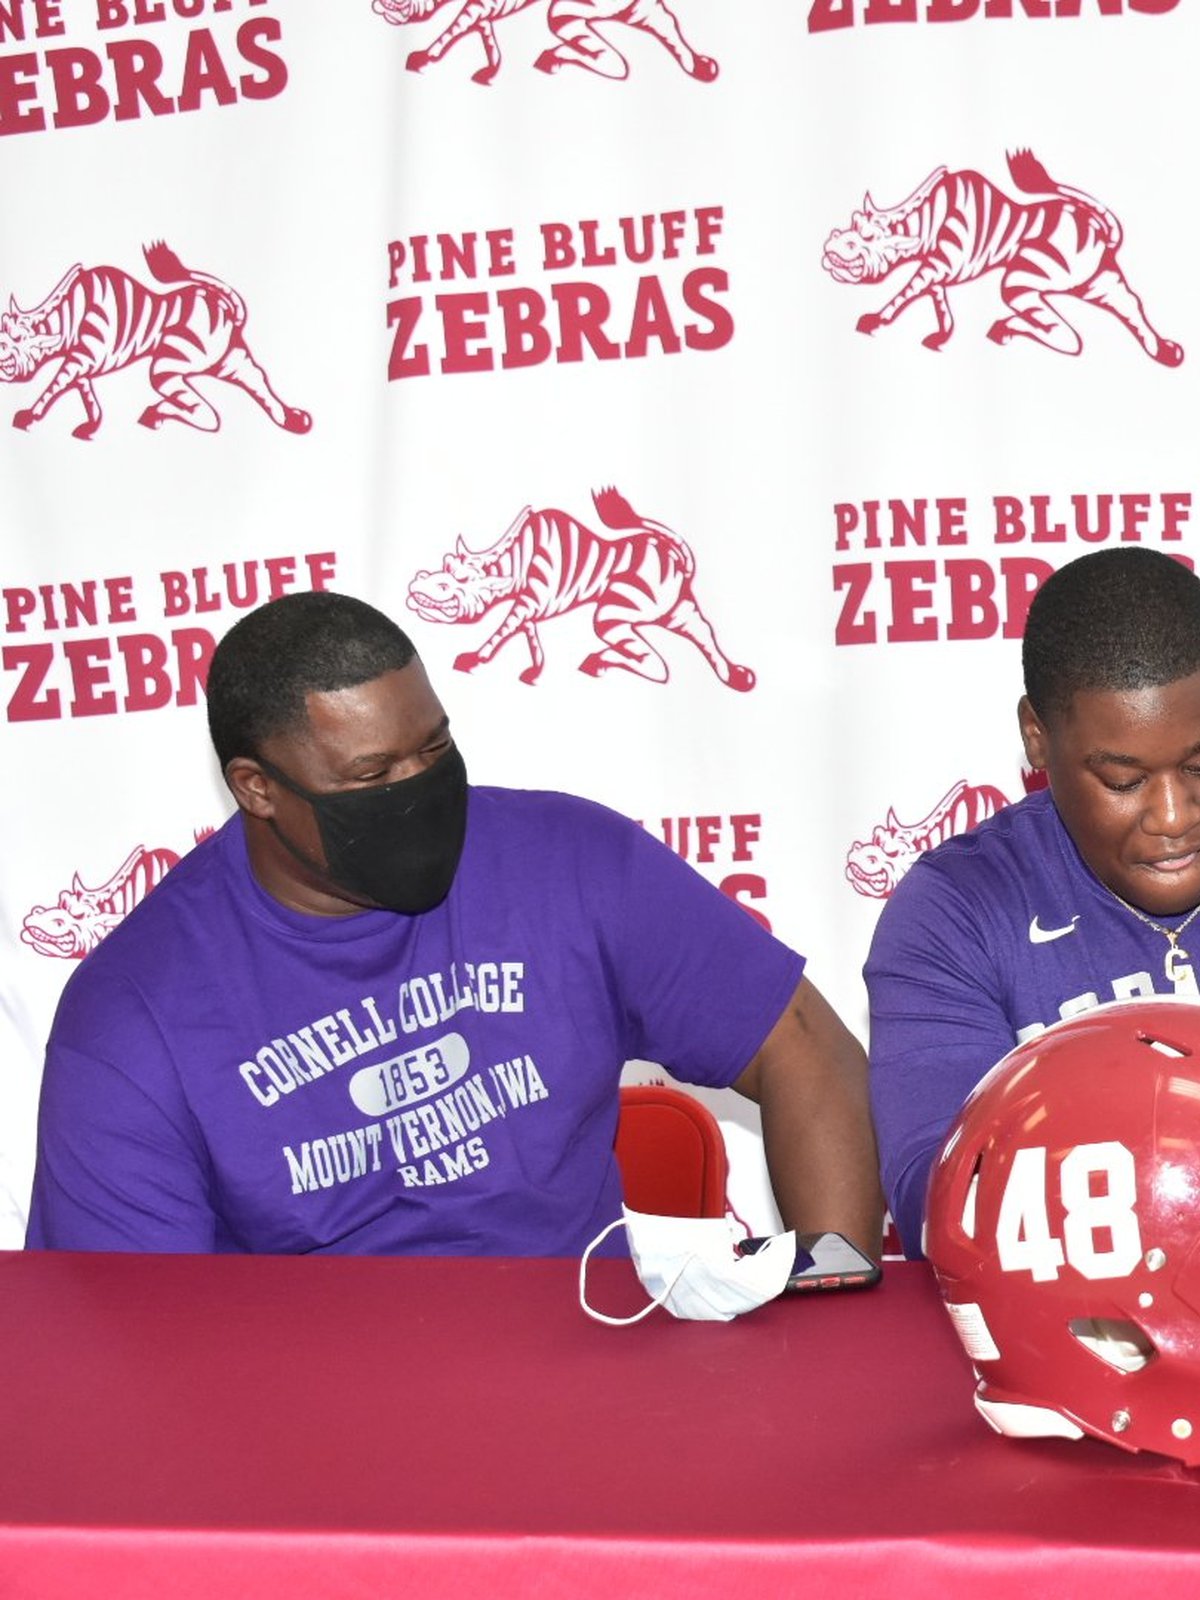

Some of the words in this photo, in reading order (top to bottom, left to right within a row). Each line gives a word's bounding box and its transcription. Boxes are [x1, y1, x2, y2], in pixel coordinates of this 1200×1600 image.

[0, 17, 289, 137] EBRAS
[388, 229, 517, 288] PINE
[541, 206, 725, 271] BLUFF
[387, 266, 735, 381] ZEBRAS
[836, 498, 968, 551] PINE
[993, 492, 1192, 545] BLUFF
[3, 576, 137, 633] PINE
[160, 551, 337, 618] BLUFF
[832, 553, 1196, 646] ZEBR
[2, 627, 217, 723] ZEBR
[635, 813, 762, 865] UFF
[238, 996, 398, 1107] CORNELL
[378, 1047, 450, 1108] 1853
[282, 1123, 382, 1195] MOUNT
[397, 1136, 490, 1188] RAMS
[995, 1140, 1143, 1283] 48
